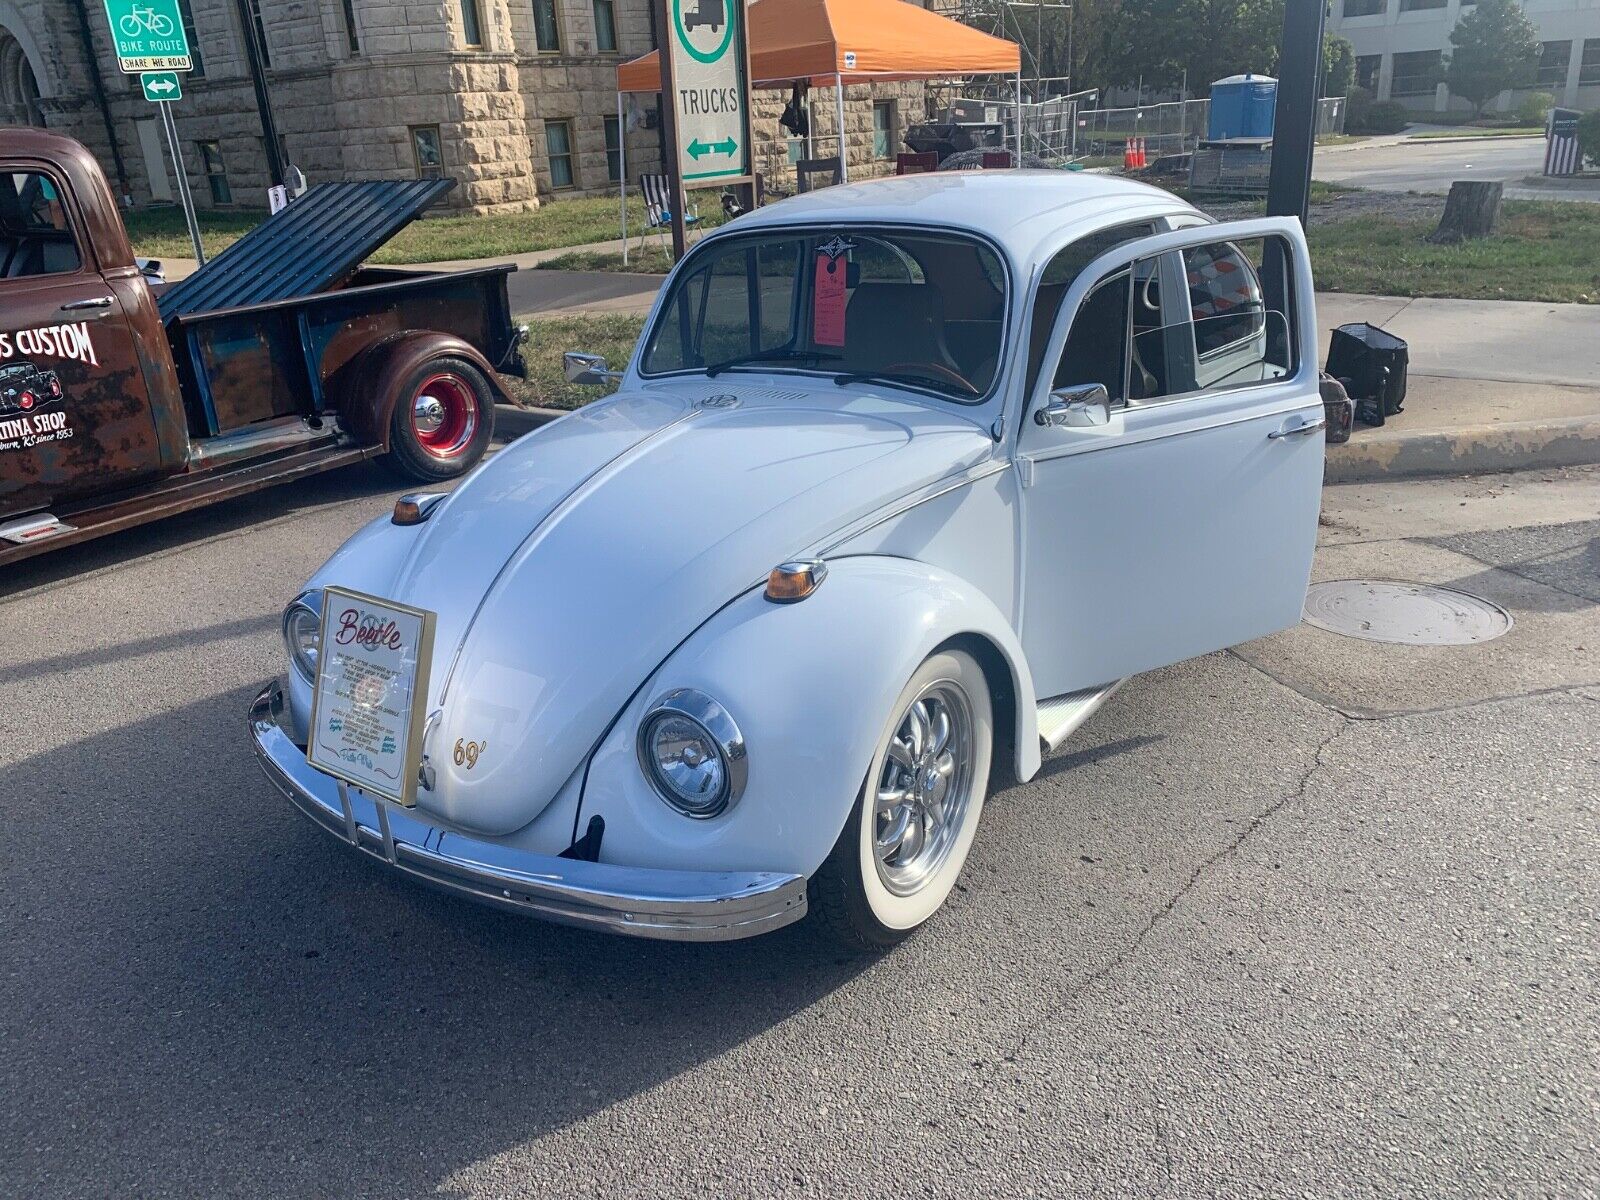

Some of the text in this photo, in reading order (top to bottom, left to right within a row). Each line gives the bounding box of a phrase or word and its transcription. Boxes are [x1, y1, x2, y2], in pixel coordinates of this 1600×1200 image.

[120, 39, 183, 52] BIKE ROUTE
[124, 57, 187, 68] SHARE THE ROAD
[680, 87, 738, 115] TRUCKS
[16, 321, 99, 366] CUSTOM
[33, 412, 66, 433] SHOP
[36, 433, 55, 444] since
[56, 428, 74, 440] 1953
[335, 608, 402, 650] Beetle
[454, 738, 487, 770] 69'
